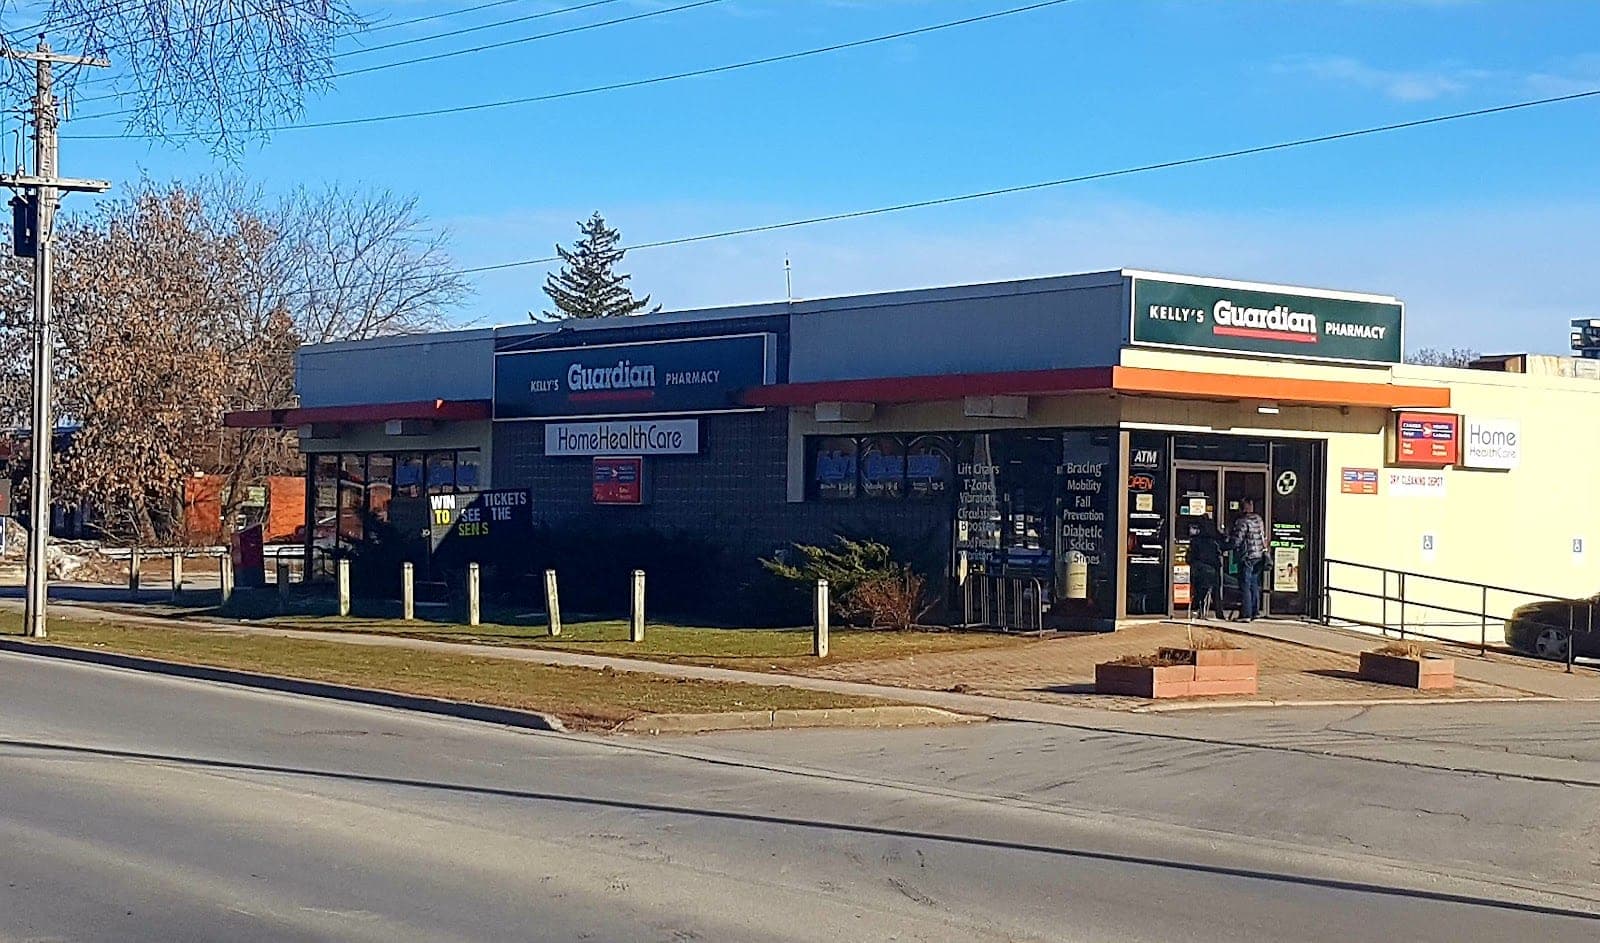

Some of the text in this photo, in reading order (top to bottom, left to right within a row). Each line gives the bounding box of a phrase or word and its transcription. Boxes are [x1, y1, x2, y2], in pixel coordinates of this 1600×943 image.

[1149, 299, 1386, 339] KELLY'S Guardian PHARMACY
[530, 360, 720, 393] KELLY'S Guardian PHARMACY
[558, 424, 682, 450] HomeHealthCare
[1470, 423, 1516, 446] Home
[1134, 450, 1157, 463] ATM
[957, 463, 1000, 475] Lift Chairs
[1066, 462, 1102, 477] Bracing
[1067, 479, 1102, 494] Mobility
[1128, 475, 1153, 490] OPEN
[430, 492, 527, 510] WIN TICKETS
[1075, 496, 1091, 507] Fall
[434, 507, 512, 524] TO SEE THE
[1063, 508, 1104, 521] Prevention
[1063, 524, 1103, 538] Diabetic
[1069, 538, 1095, 551] Socks
[1074, 552, 1100, 565] Shoes
